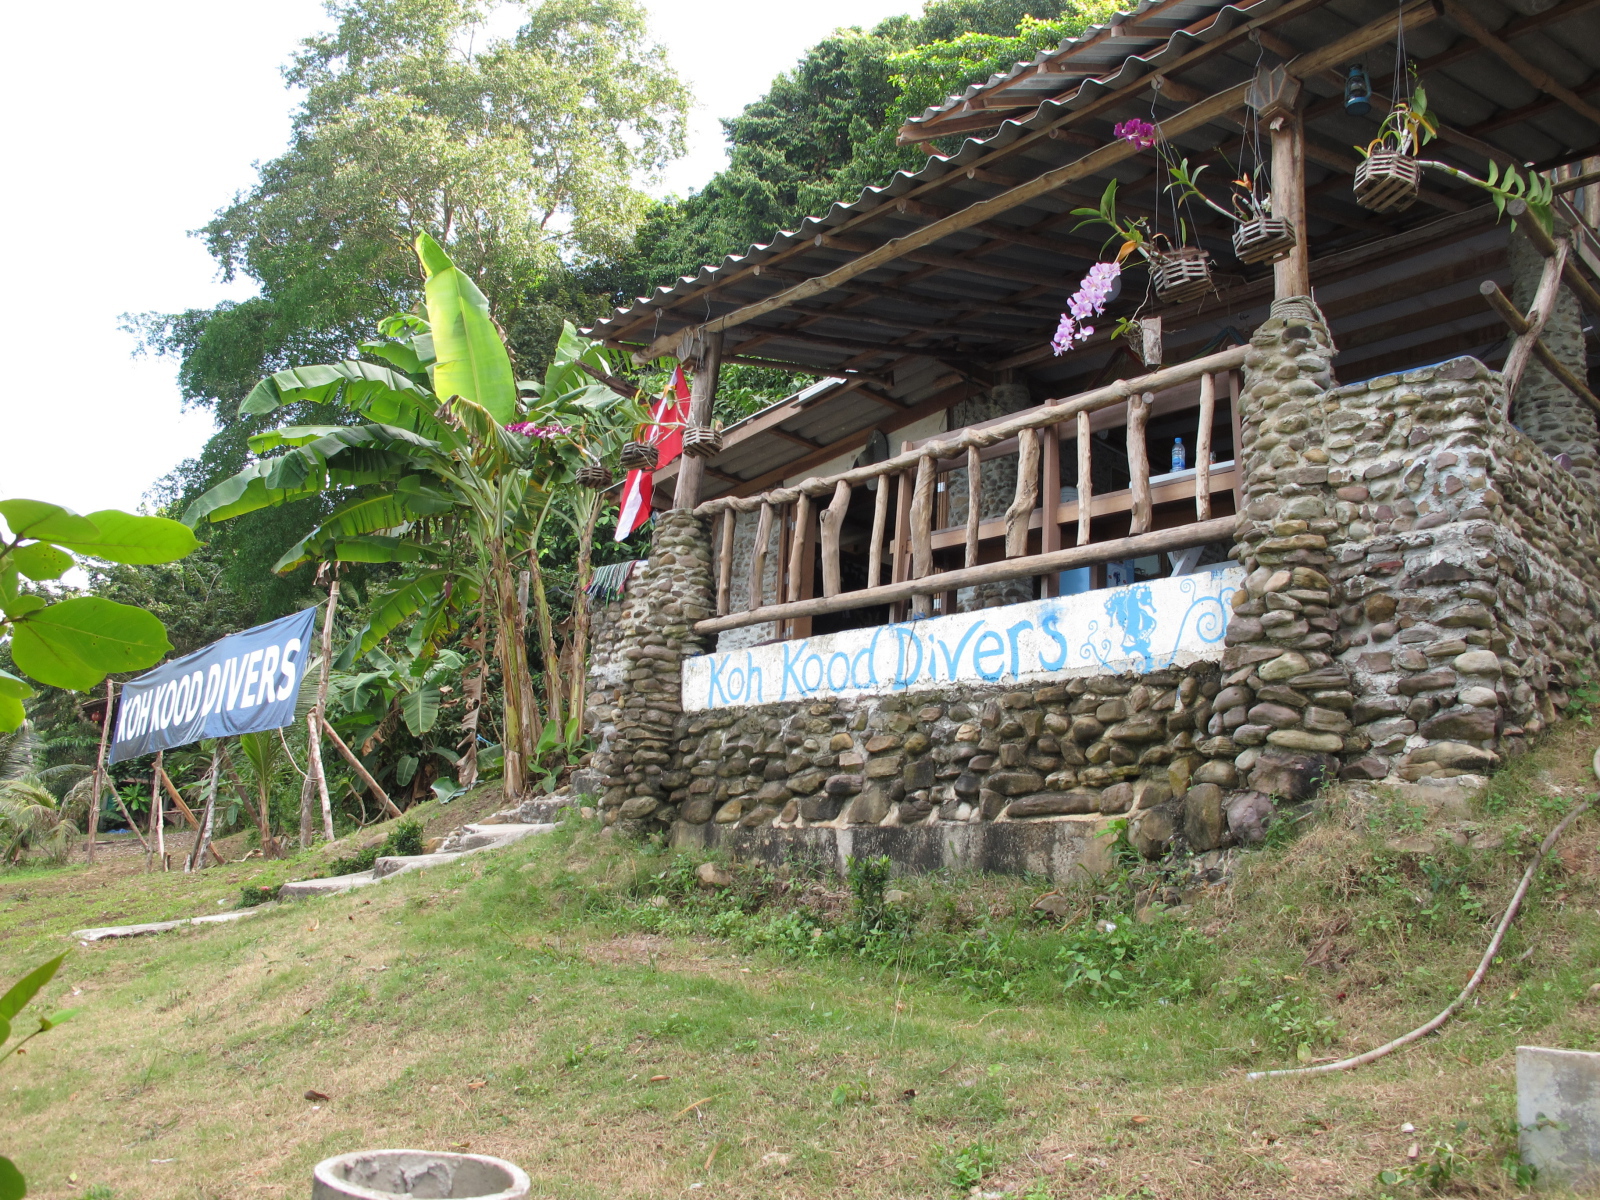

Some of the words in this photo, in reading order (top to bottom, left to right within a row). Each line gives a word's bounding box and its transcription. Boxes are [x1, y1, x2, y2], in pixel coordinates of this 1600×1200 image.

[116, 689, 153, 743] KOH
[149, 670, 204, 733] KOOD
[201, 638, 301, 717] DIVERS
[707, 651, 764, 709] Koh
[779, 626, 884, 701] Kood
[891, 612, 1068, 691] Divers
